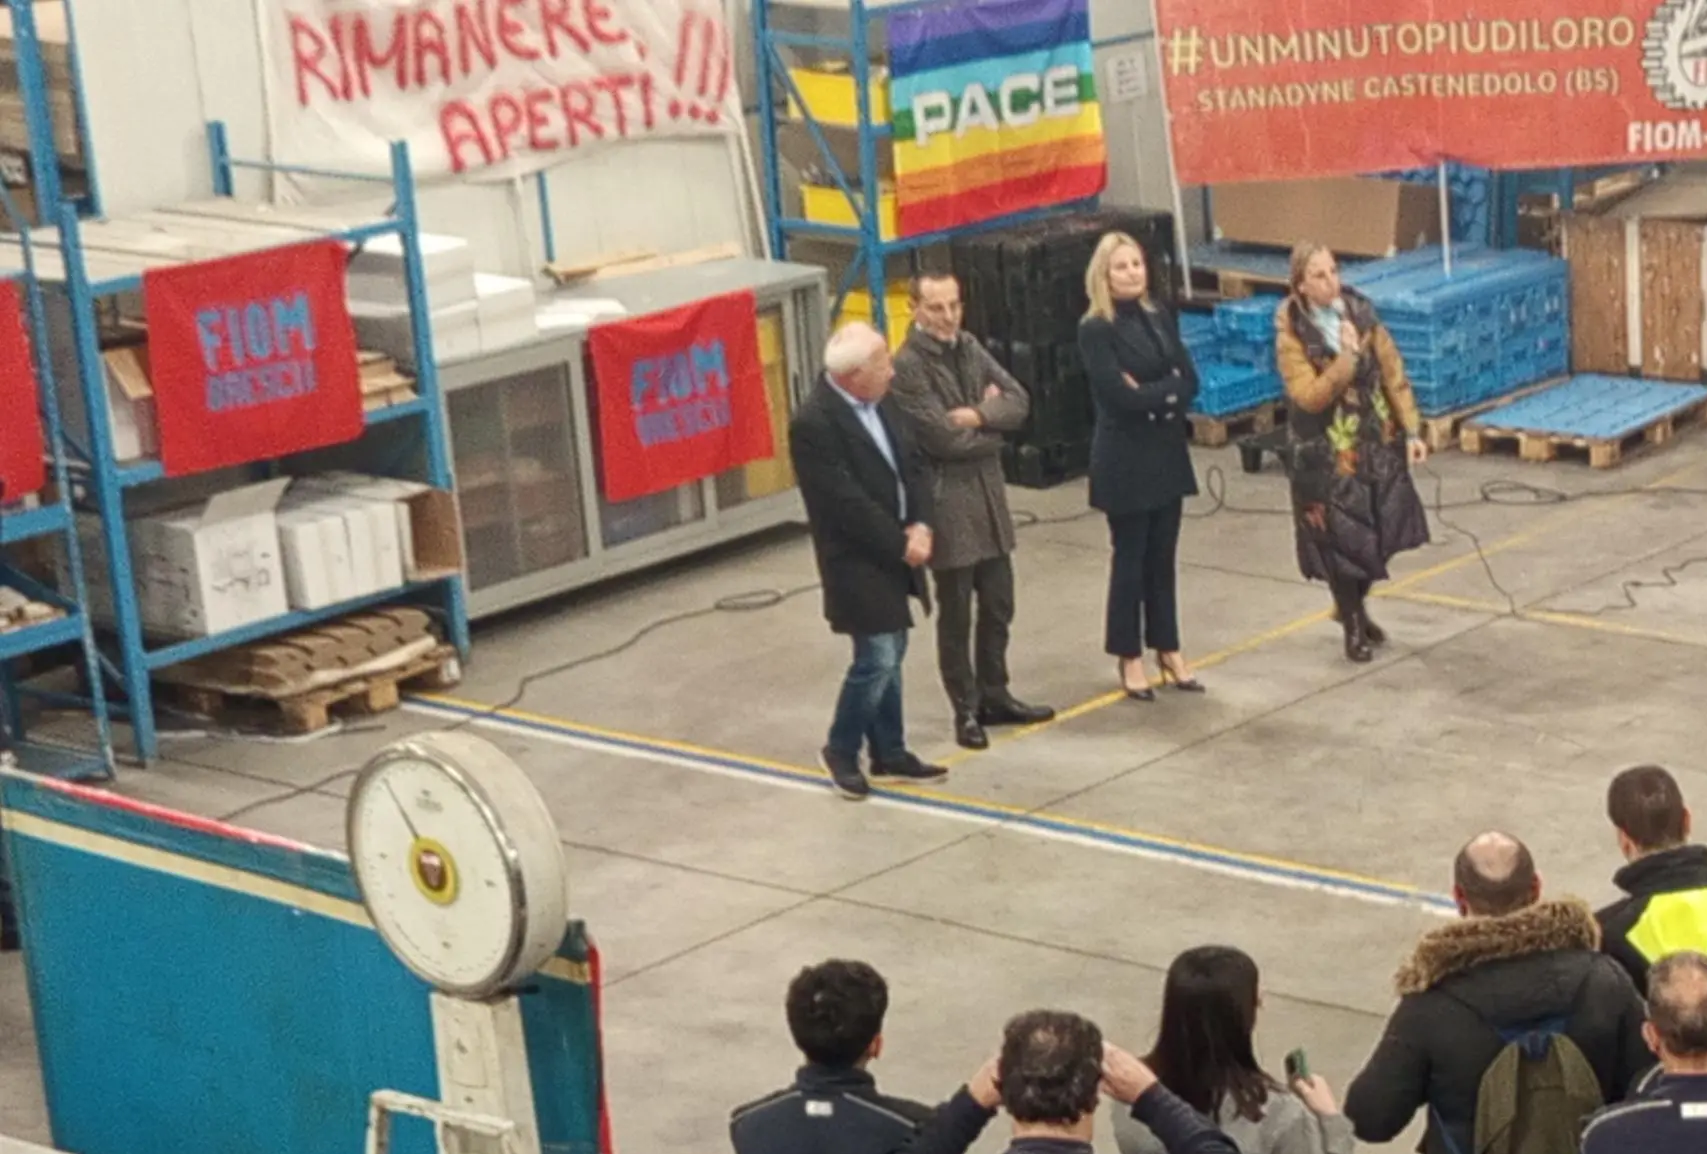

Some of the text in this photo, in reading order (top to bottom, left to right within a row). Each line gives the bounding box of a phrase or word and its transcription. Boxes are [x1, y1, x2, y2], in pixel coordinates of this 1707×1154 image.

[913, 65, 1080, 148] PACE
[1197, 67, 1620, 113] STANADYNE CASTENEDOLO (BS)
[196, 289, 317, 373] FIOM
[631, 338, 730, 411] FIOM
